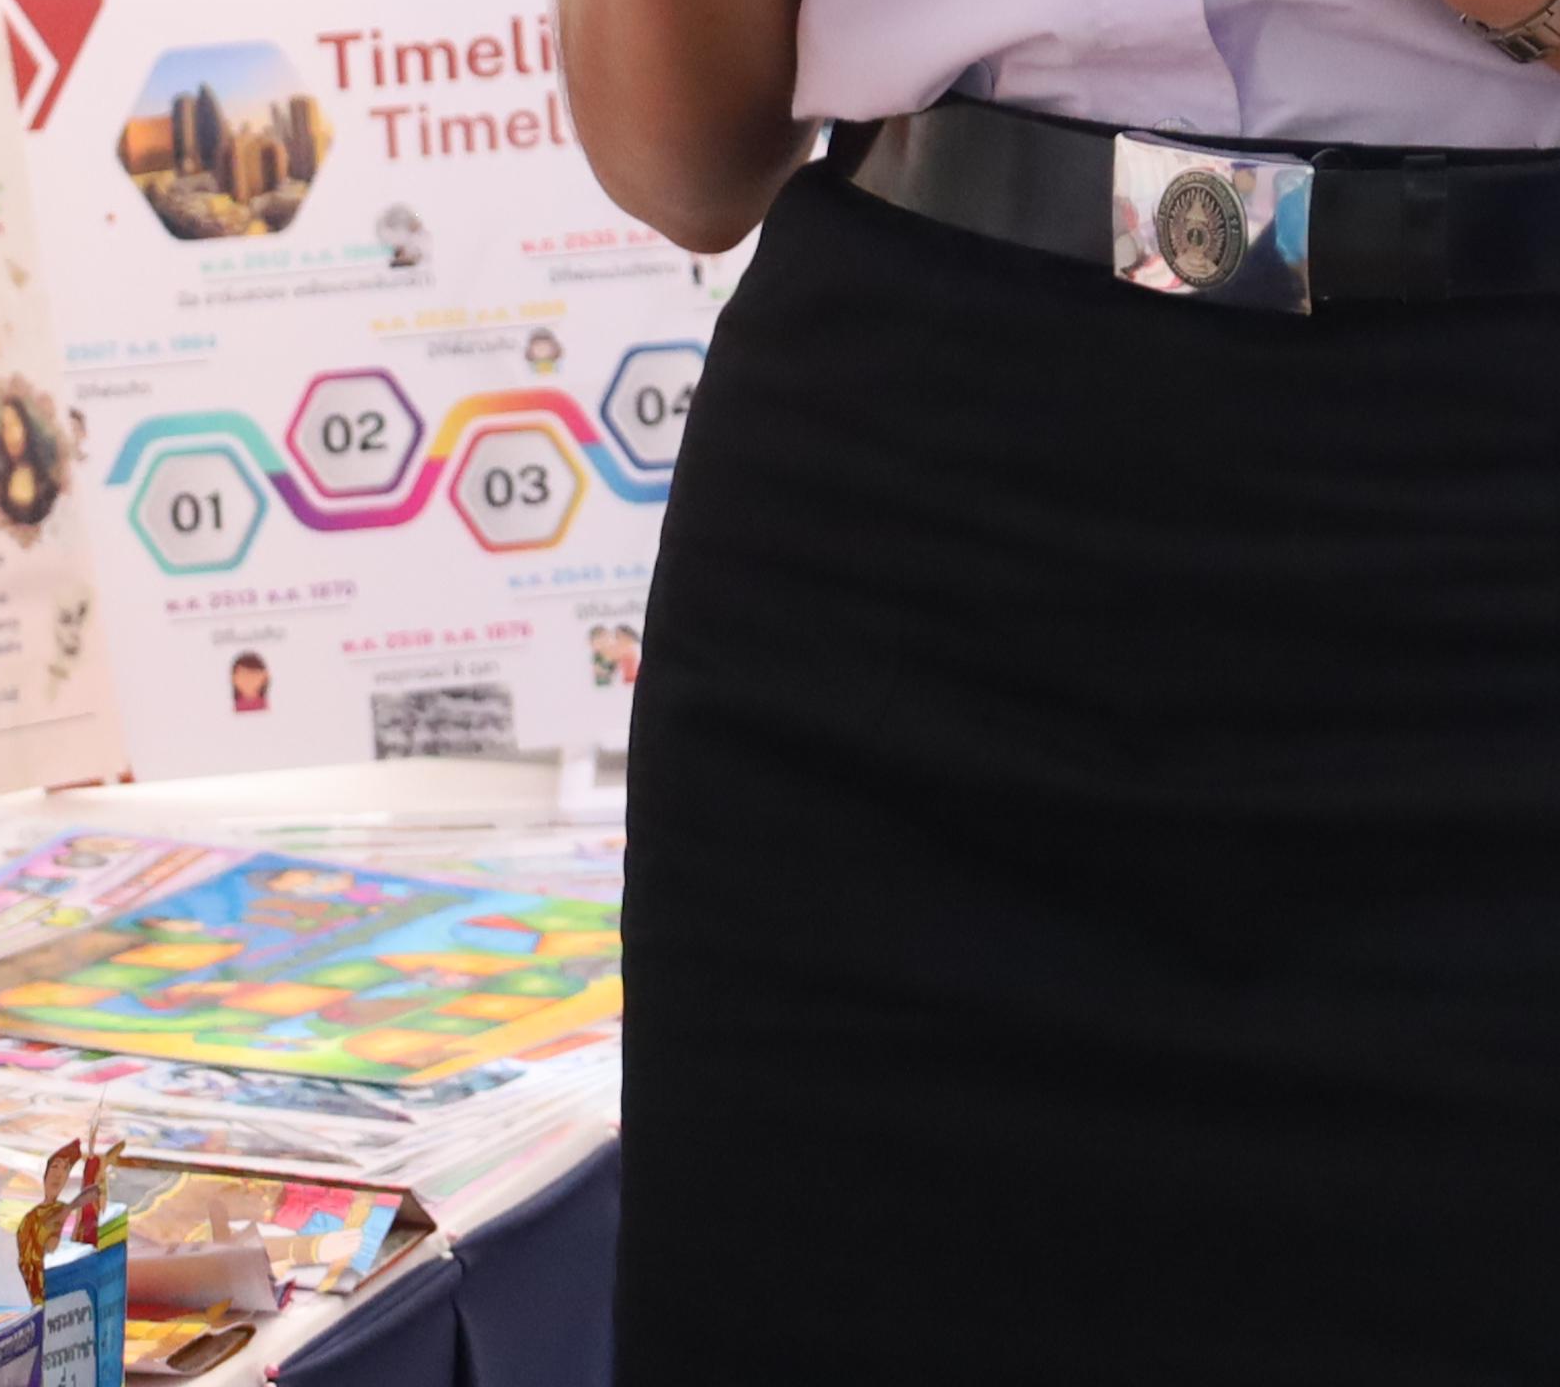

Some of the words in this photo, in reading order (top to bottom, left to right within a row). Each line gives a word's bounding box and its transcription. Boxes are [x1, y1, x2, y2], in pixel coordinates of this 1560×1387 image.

[317, 13, 557, 91] Timeli
[368, 90, 567, 161] Timel
[321, 411, 389, 455] 02
[483, 464, 552, 508] 03
[170, 492, 225, 533] 01
